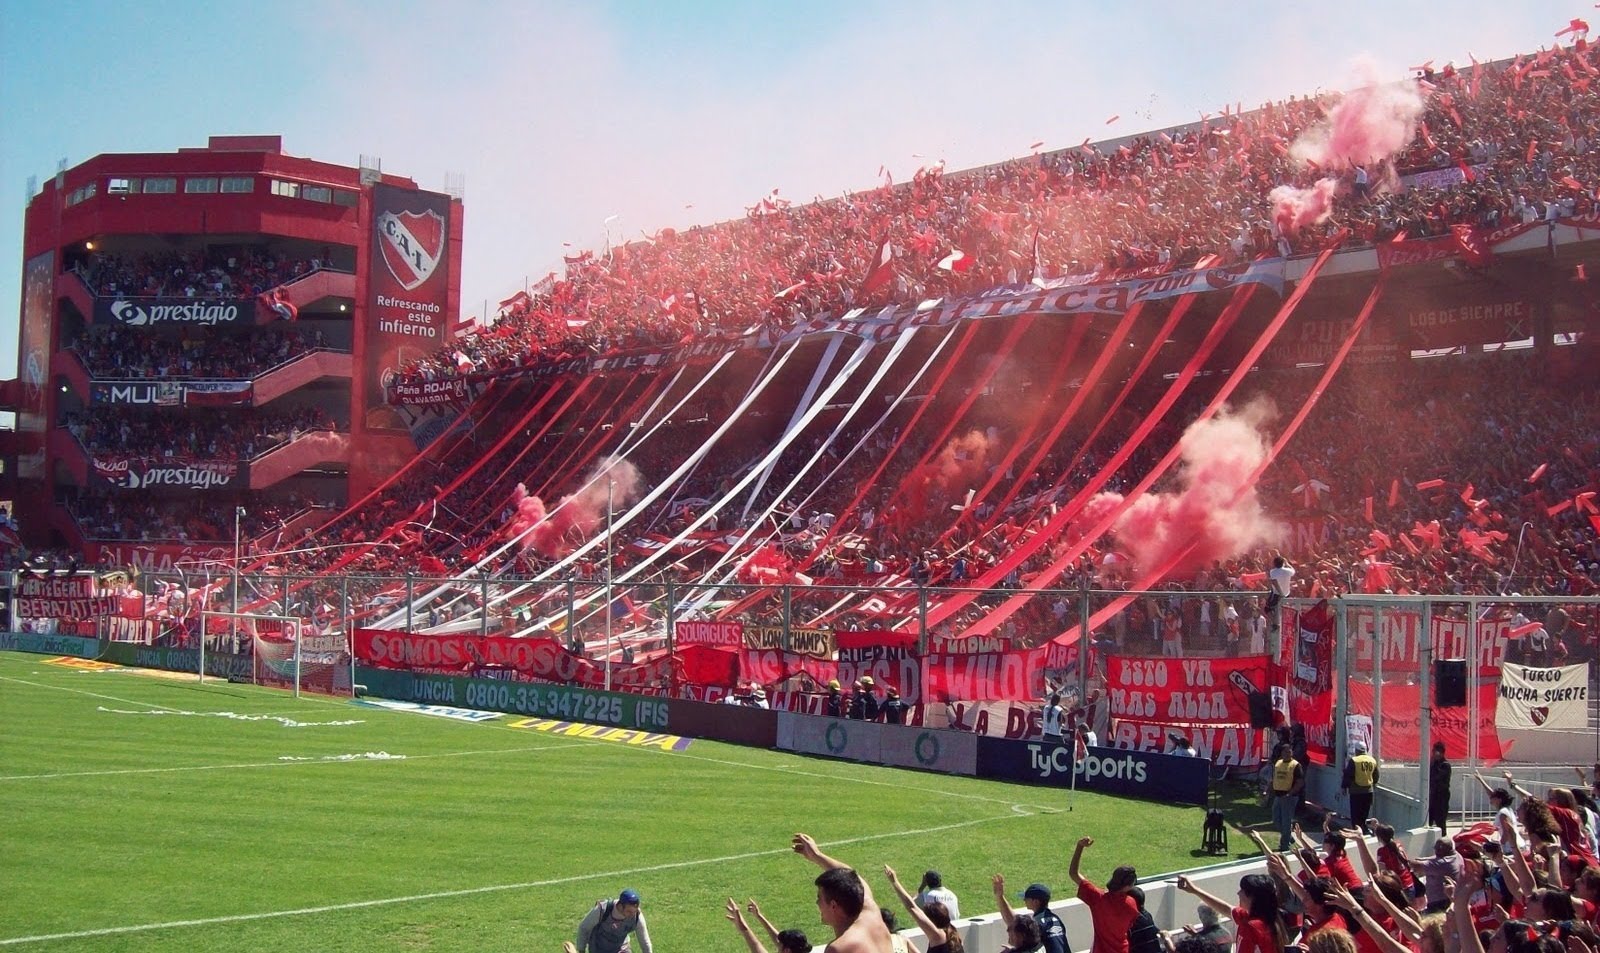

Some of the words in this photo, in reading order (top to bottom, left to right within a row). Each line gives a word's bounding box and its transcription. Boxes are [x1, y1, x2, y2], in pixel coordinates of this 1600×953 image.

[1134, 273, 1196, 300] 2010
[149, 302, 238, 326] prestigio
[377, 296, 440, 313] Refrescando
[1408, 311, 1437, 328] LOS
[1440, 309, 1456, 324] DE
[1460, 301, 1524, 321] SIEMPRE
[380, 318, 436, 338] infierno
[408, 312, 431, 324] este
[397, 385, 420, 395] Peña
[424, 381, 453, 393] ROJA
[402, 394, 451, 404] OLAVARRIA
[20, 597, 121, 618] BERAZATEGUI
[678, 624, 740, 644] SOURIGUES
[762, 629, 829, 654] LONCHAMPS
[1356, 614, 1407, 662] SAN
[1413, 614, 1511, 668] NICOAS
[370, 634, 460, 666] SOMOS
[944, 650, 1045, 701] WILDE
[1119, 659, 1168, 687] ESTO
[1521, 668, 1562, 682] TURCO
[466, 682, 623, 724] 0800-33-347225
[1111, 687, 1157, 717] MAS
[1168, 691, 1229, 719] ALLA
[1500, 684, 1538, 702] MUCHA
[1544, 686, 1587, 702] SUERTE
[560, 723, 681, 750] NUEVA
[1028, 744, 1068, 777] TyC
